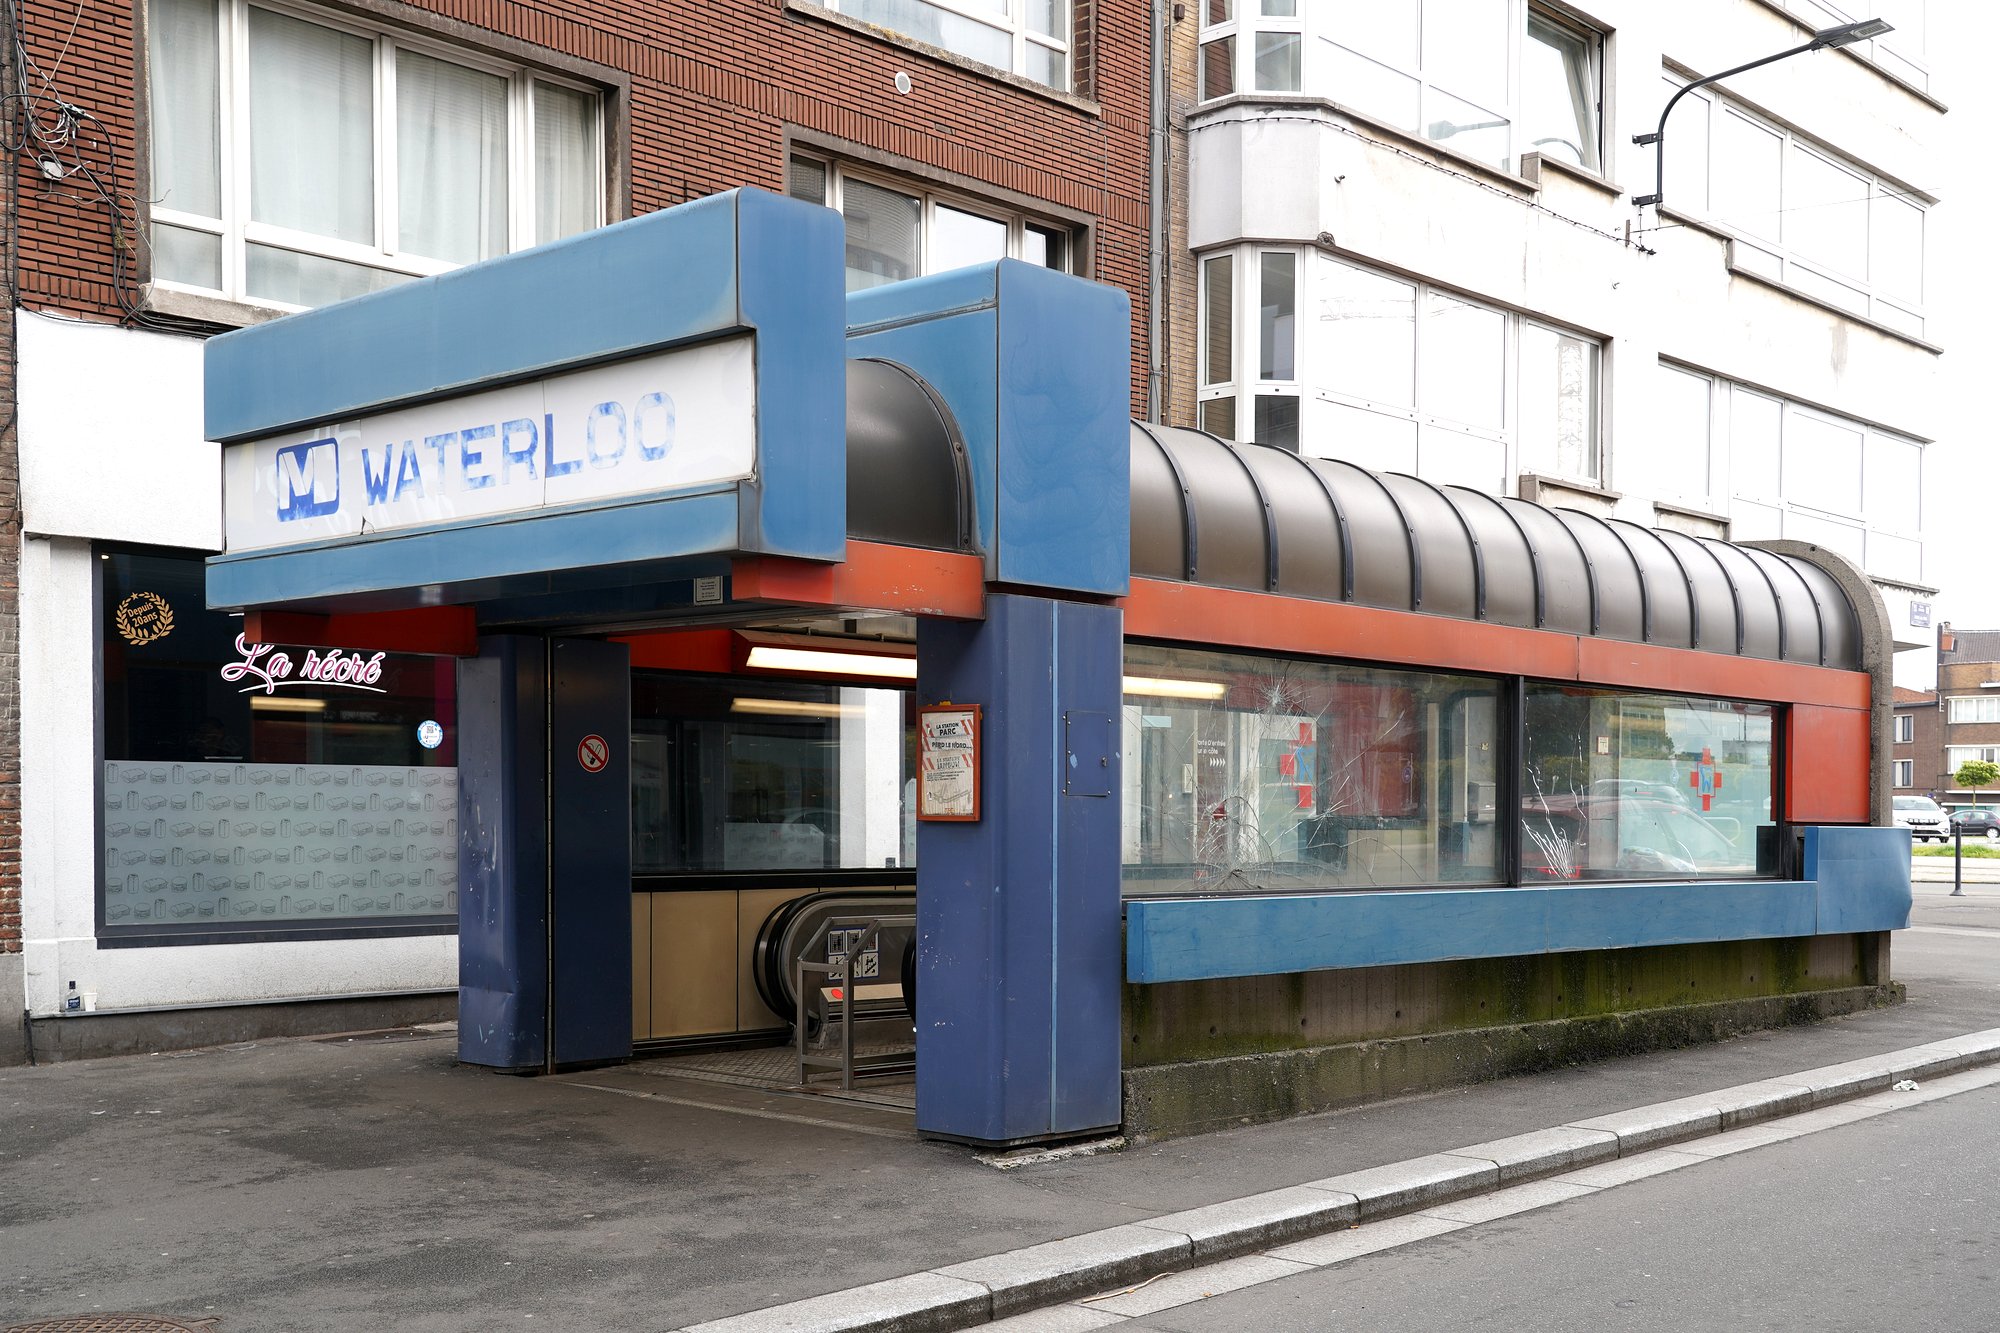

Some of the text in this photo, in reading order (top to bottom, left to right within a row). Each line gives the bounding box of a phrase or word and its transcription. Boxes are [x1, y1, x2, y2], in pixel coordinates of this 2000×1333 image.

[361, 390, 677, 507] WATERLOO
[127, 602, 154, 617] Depuis
[132, 611, 158, 627] 20ans
[221, 631, 387, 695] La récré
[939, 728, 957, 736] PARC
